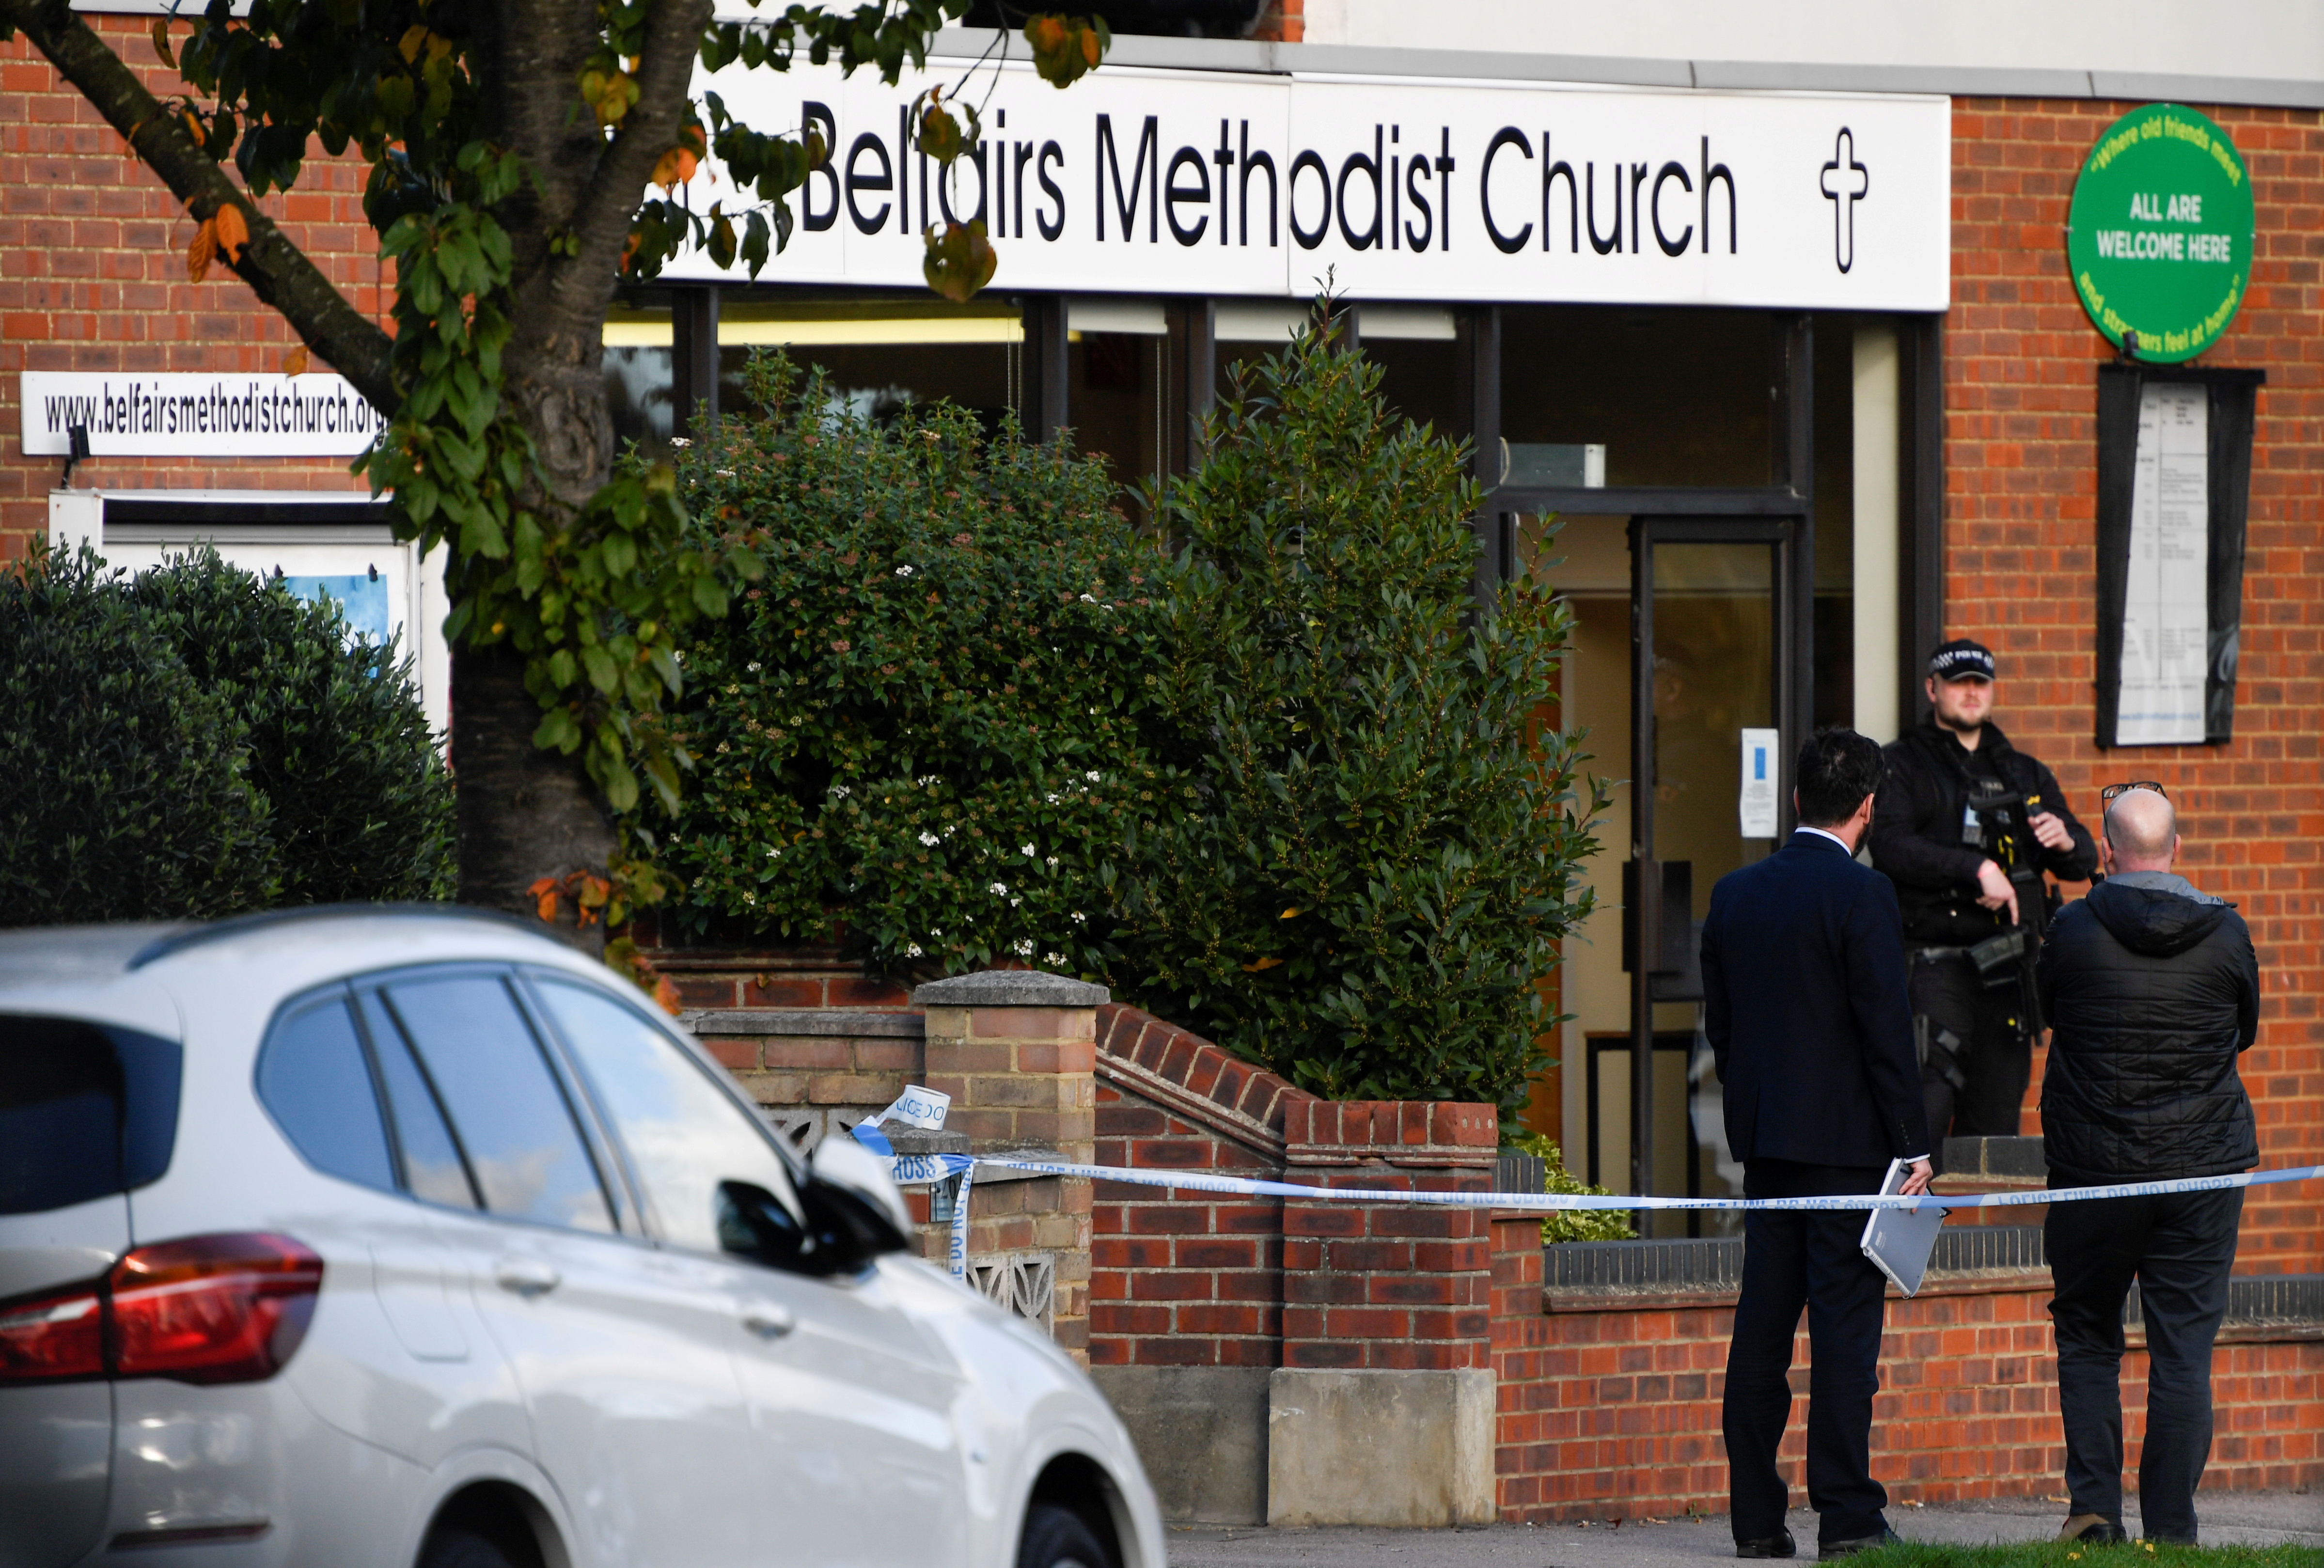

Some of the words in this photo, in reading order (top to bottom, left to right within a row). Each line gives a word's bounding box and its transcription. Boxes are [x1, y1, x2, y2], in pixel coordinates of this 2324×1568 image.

[801, 100, 1066, 242] Belfairs
[1095, 112, 1455, 253] Methodist
[1480, 125, 1736, 257] Church
[2129, 192, 2163, 221] ALL
[2166, 194, 2202, 223] ARE
[2096, 230, 2184, 261] WELCOME
[2188, 234, 2231, 263] HERE
